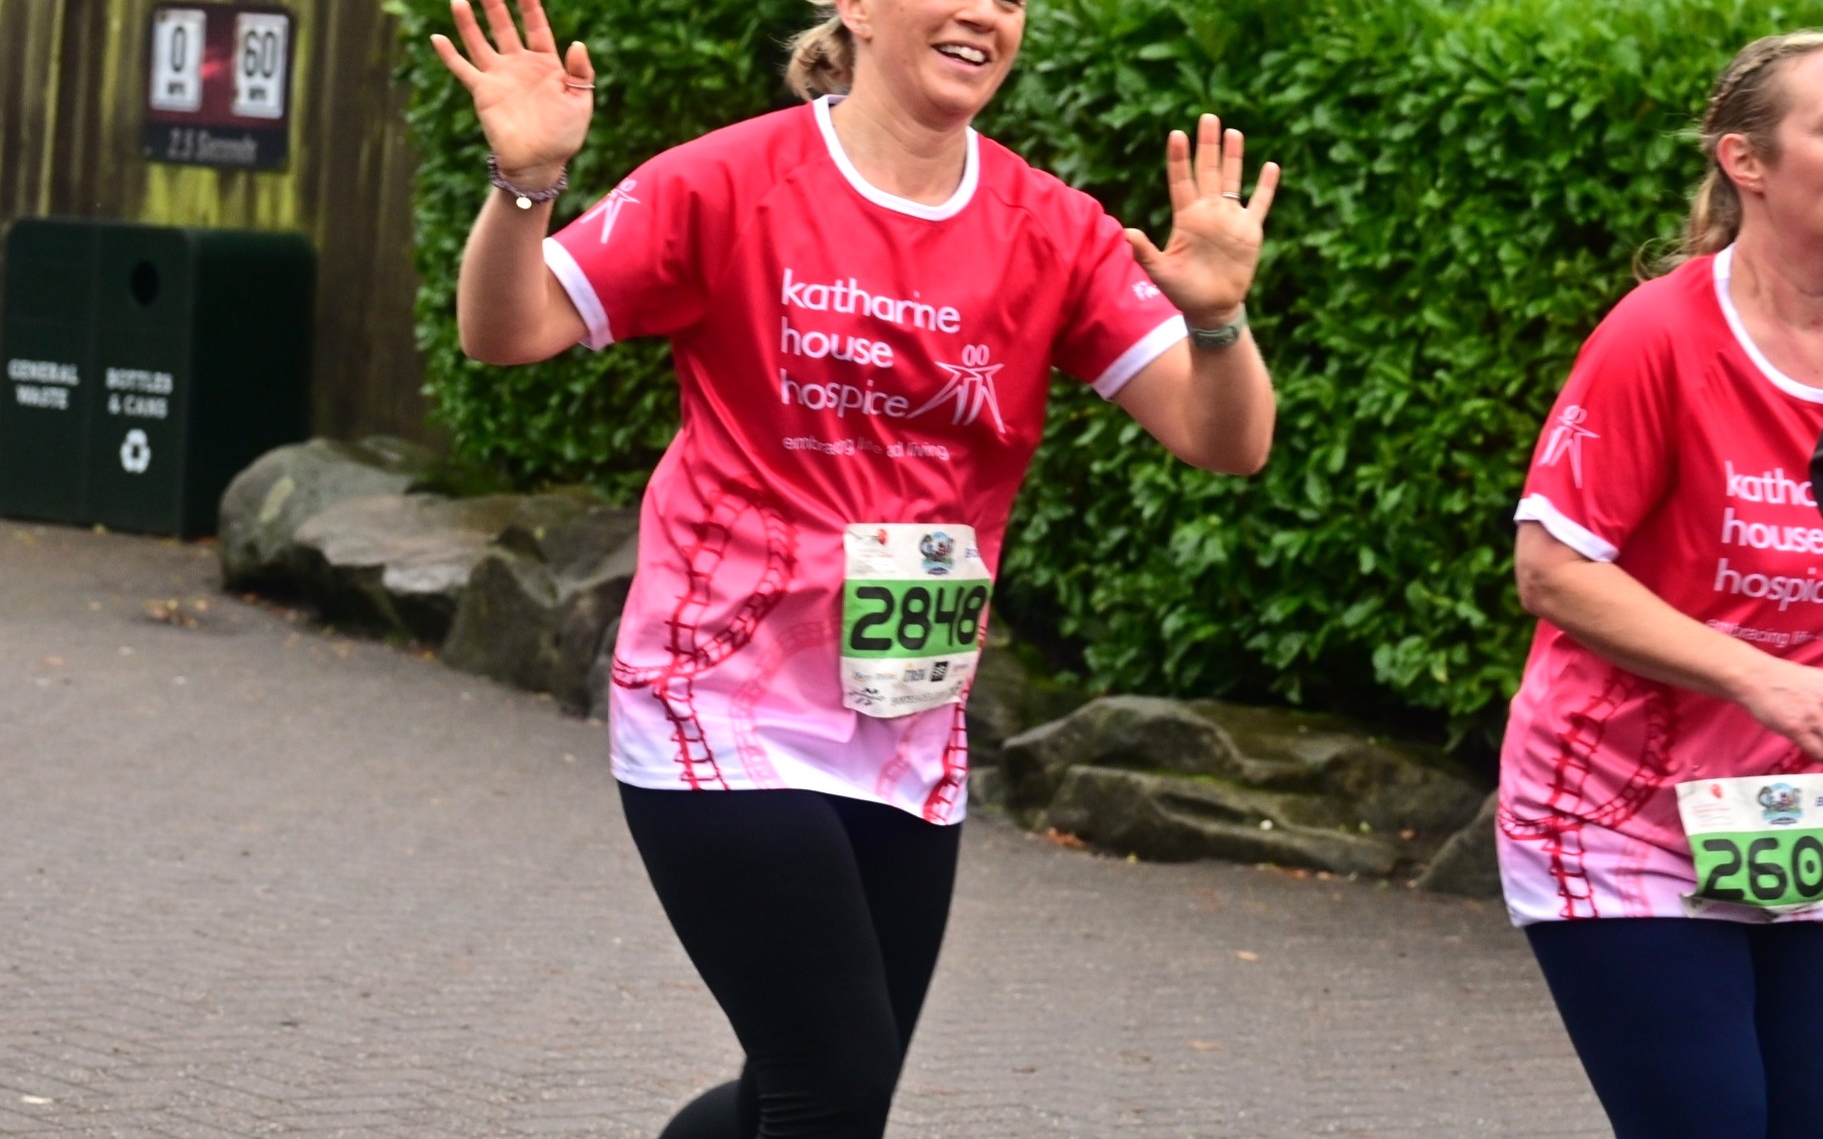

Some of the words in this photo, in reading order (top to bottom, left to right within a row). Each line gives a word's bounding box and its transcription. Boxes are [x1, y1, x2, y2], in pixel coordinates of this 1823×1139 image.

[170, 25, 187, 72] 0
[245, 29, 276, 78] 60
[780, 268, 961, 334] katharine
[780, 316, 895, 368] house
[8, 358, 80, 386] GENERAL
[15, 383, 70, 410] WASTE
[106, 367, 173, 394] BOTTLES
[779, 368, 910, 418] hospice
[1721, 507, 1823, 555] house
[850, 585, 988, 651] 2848
[1703, 836, 1823, 900] 260
